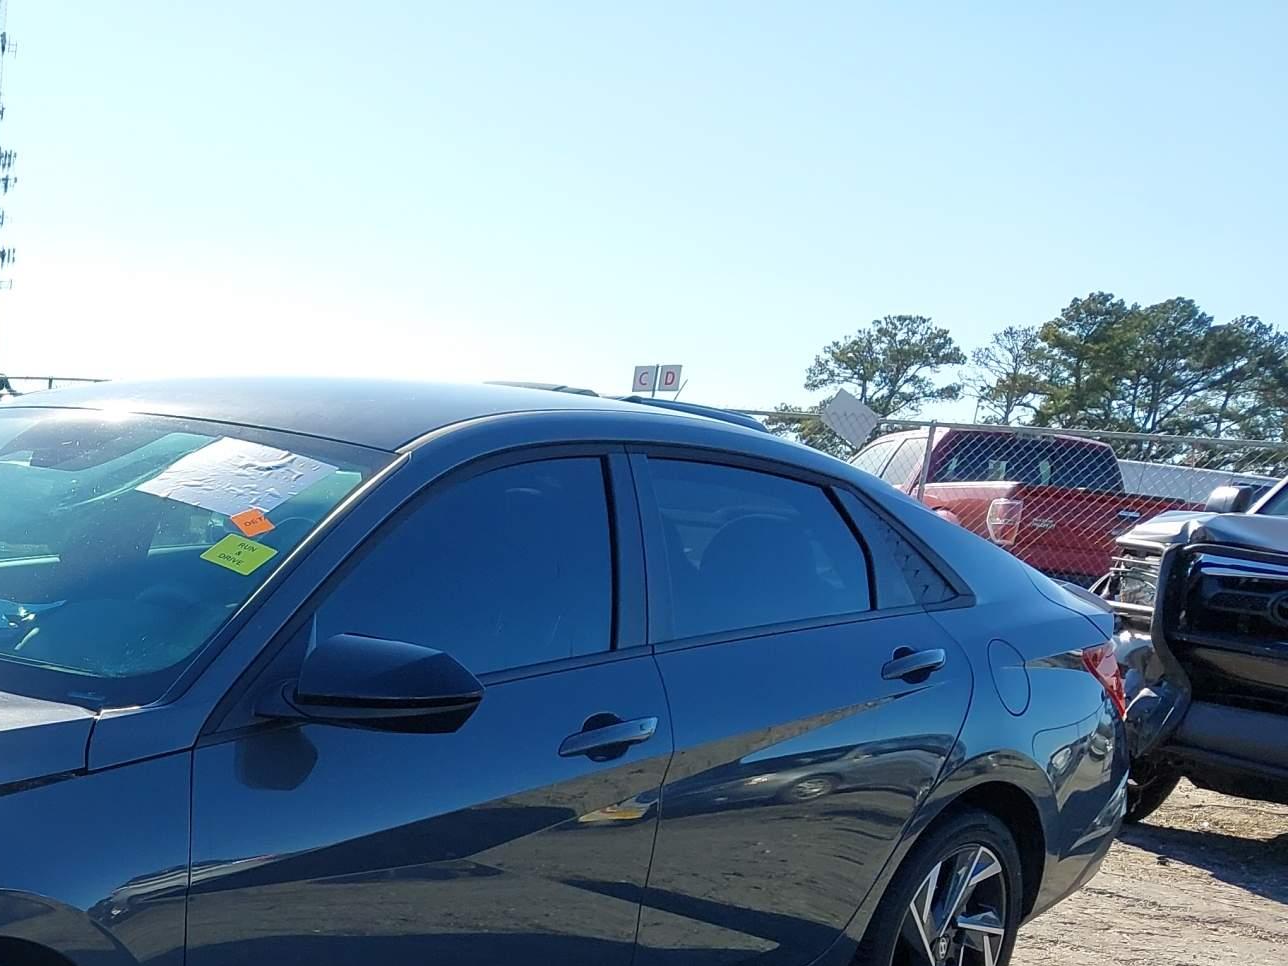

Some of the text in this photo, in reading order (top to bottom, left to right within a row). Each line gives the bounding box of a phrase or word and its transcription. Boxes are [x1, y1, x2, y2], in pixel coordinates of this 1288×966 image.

[639, 371, 649, 386] C
[664, 371, 675, 386] D
[238, 542, 257, 552] RUN
[218, 553, 245, 566] DRIVE
